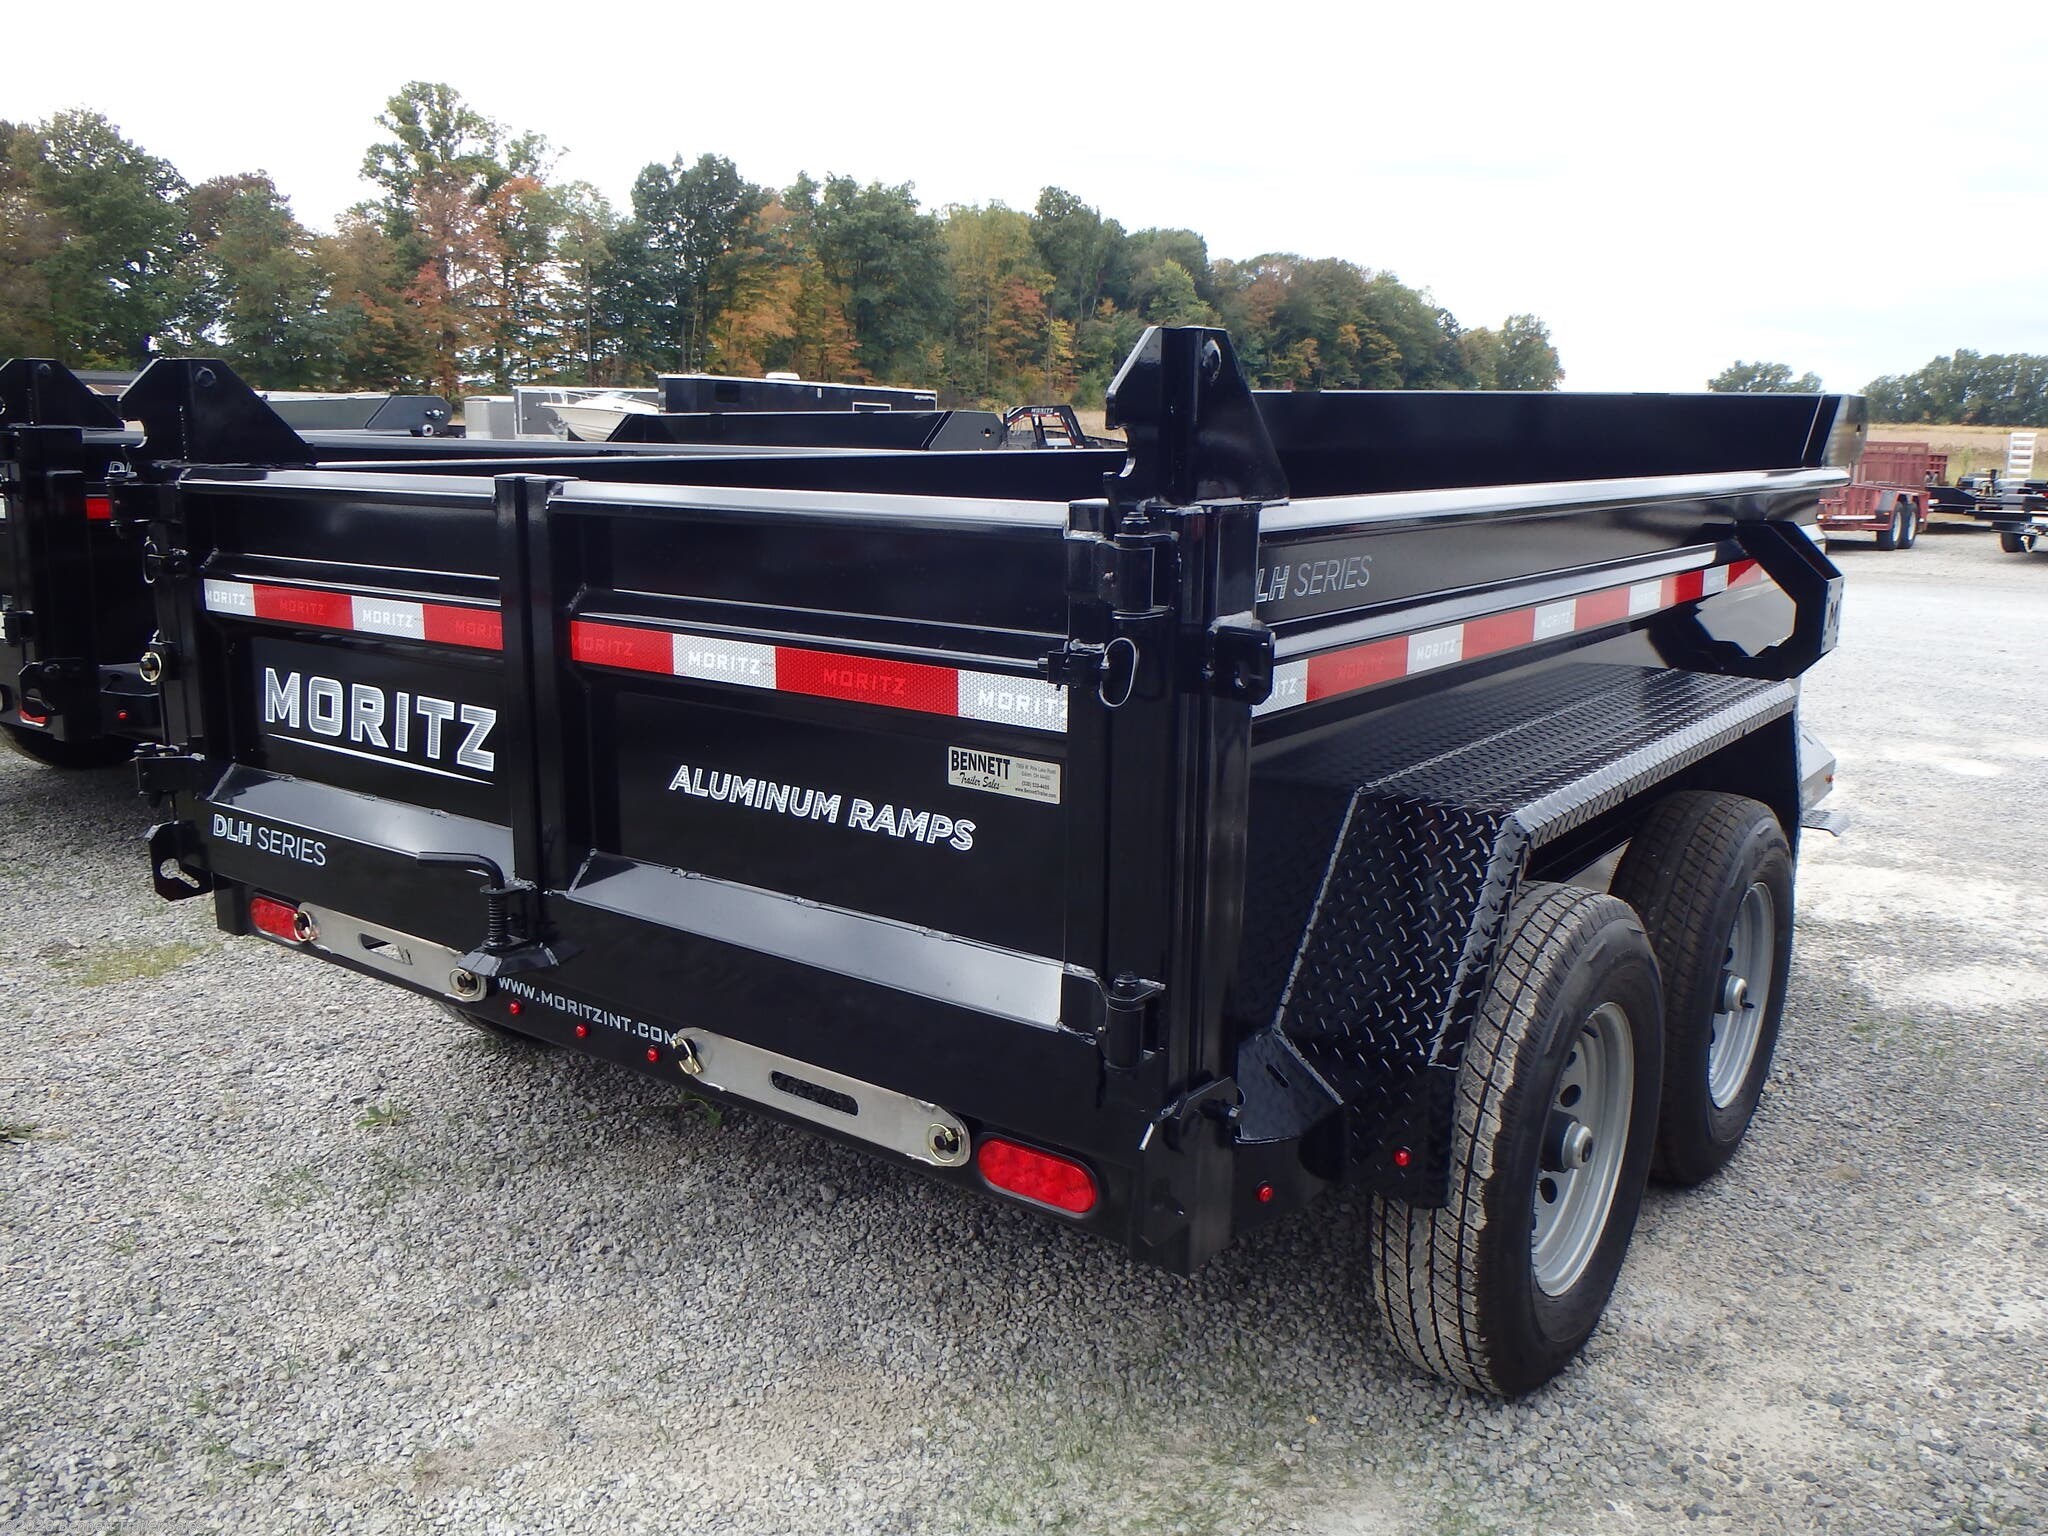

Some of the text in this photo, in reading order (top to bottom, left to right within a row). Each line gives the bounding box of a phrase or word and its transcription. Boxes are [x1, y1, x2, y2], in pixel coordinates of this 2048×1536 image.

[1294, 555, 1372, 597] SERIES
[279, 599, 325, 617] MORITZ
[362, 610, 414, 628] MORITZ
[1416, 639, 1456, 660] MORITZ
[688, 651, 761, 675] MORITZ
[823, 668, 906, 696] MORITZ
[265, 667, 497, 772] MORITZ
[951, 750, 1011, 780] BENNETT
[959, 772, 1001, 790] Trailer Sales
[669, 765, 977, 851] ALUMINUM RAMPS
[213, 813, 327, 866] DLH SERIES
